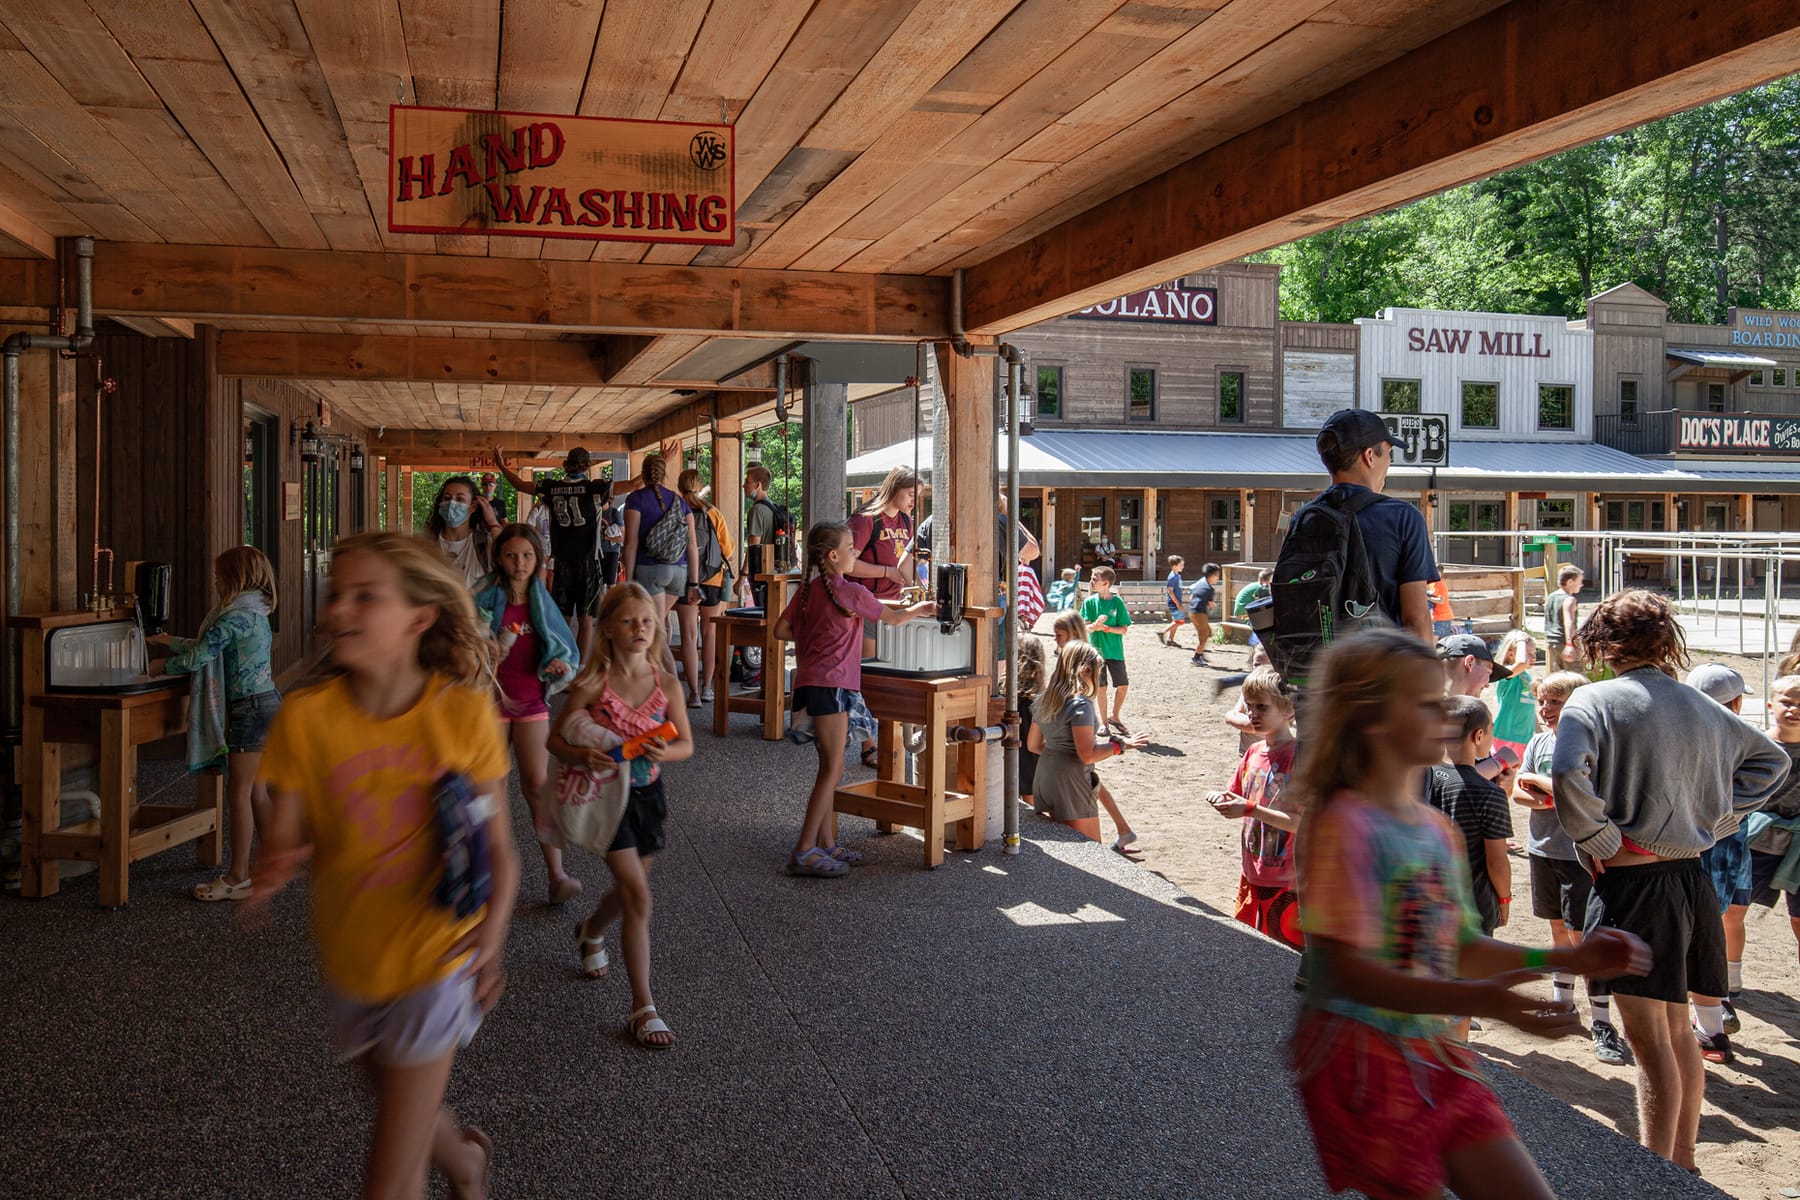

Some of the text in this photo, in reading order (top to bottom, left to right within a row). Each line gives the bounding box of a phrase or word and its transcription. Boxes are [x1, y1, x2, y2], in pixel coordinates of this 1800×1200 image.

[397, 122, 566, 202] HAND
[483, 183, 728, 233] WASHING
[1079, 290, 1213, 320] OLANO
[1744, 315, 1773, 327] WILD
[1408, 327, 1551, 358] SAW MILL
[1680, 417, 1771, 448] DOC'S PLACE
[471, 456, 512, 467] PICC
[552, 496, 587, 527] 81
